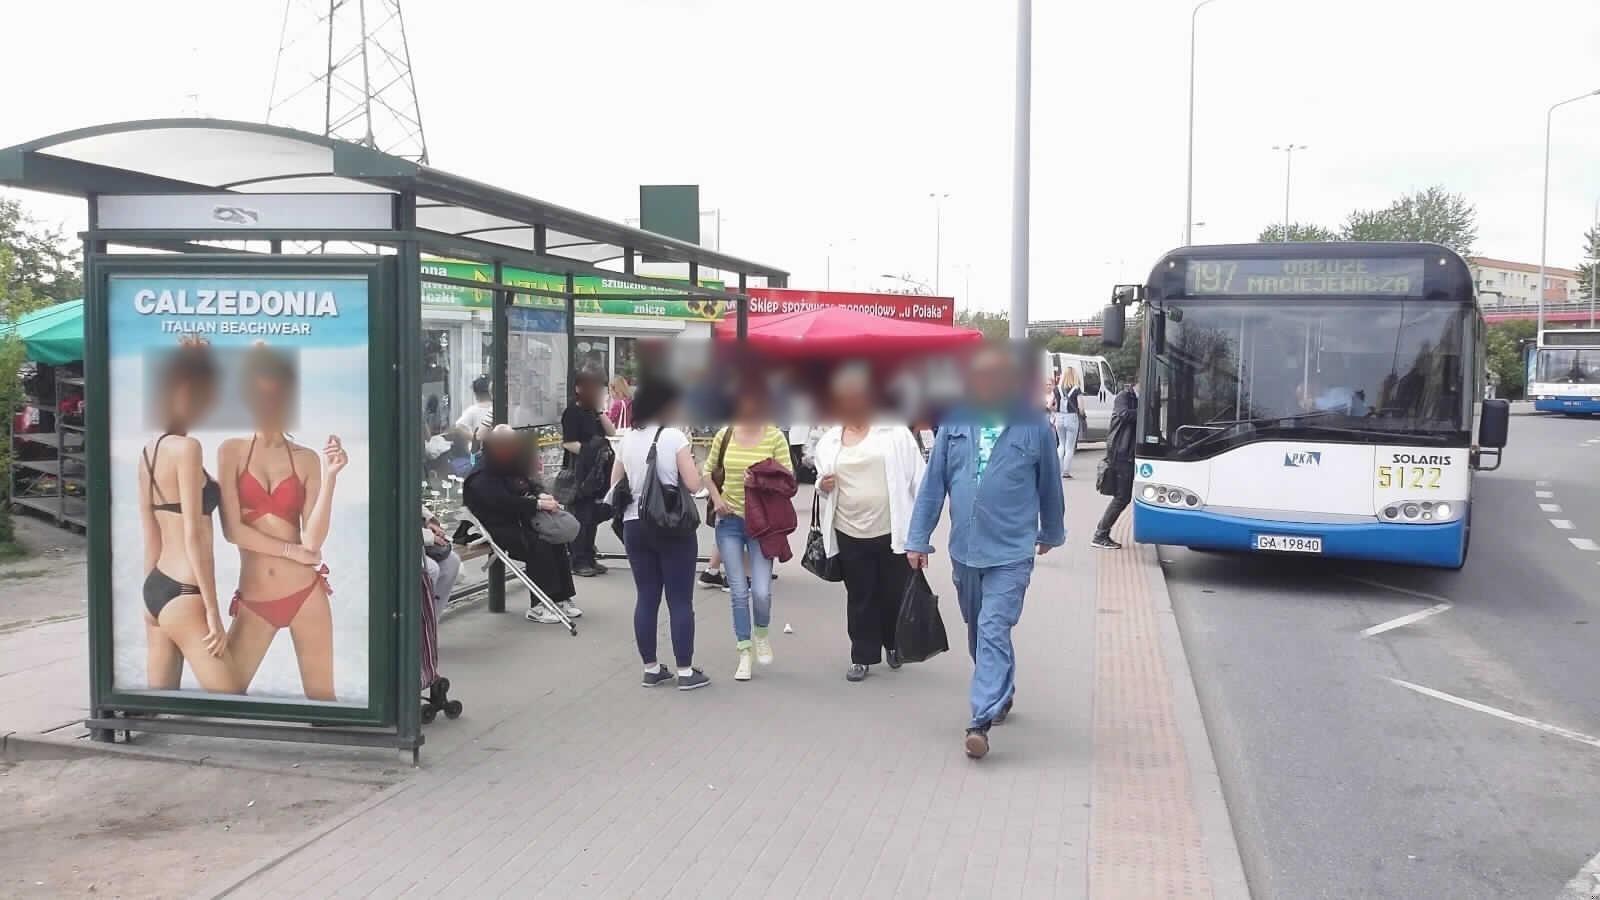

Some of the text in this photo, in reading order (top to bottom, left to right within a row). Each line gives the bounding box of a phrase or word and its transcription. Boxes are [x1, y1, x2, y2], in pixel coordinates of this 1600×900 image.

[1188, 262, 1237, 293] 197
[133, 289, 338, 318] CALZEDONIA
[633, 303, 666, 315] znicze
[750, 297, 779, 313] Sklep
[161, 320, 312, 336] ITALIAN BEACHWEAR
[1392, 454, 1452, 466] SOLARIS
[1376, 465, 1441, 489] 5122
[1260, 537, 1319, 551] GA 19840
